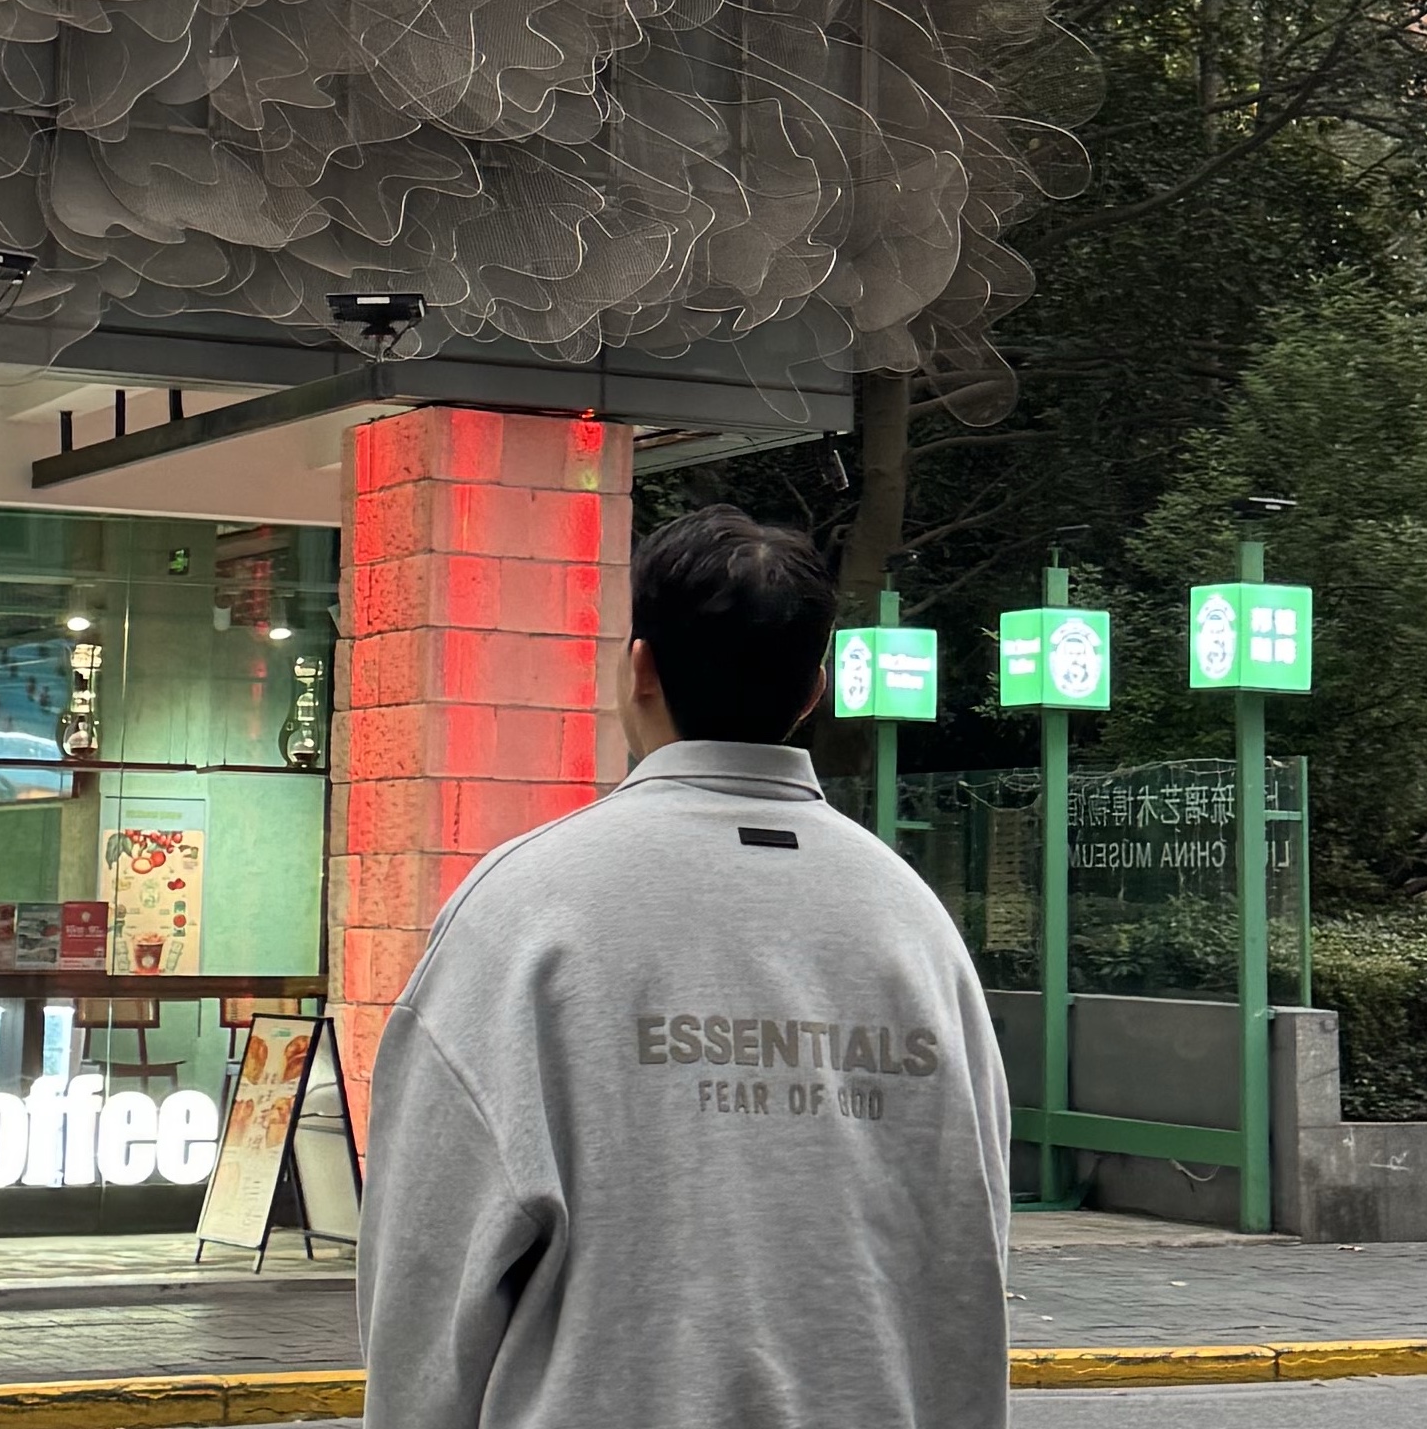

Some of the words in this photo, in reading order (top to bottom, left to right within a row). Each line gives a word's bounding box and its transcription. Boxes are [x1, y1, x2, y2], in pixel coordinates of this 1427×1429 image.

[637, 1014, 939, 1077] ESSENTIALS
[698, 1080, 770, 1116] FEAR
[788, 1083, 825, 1116] OF
